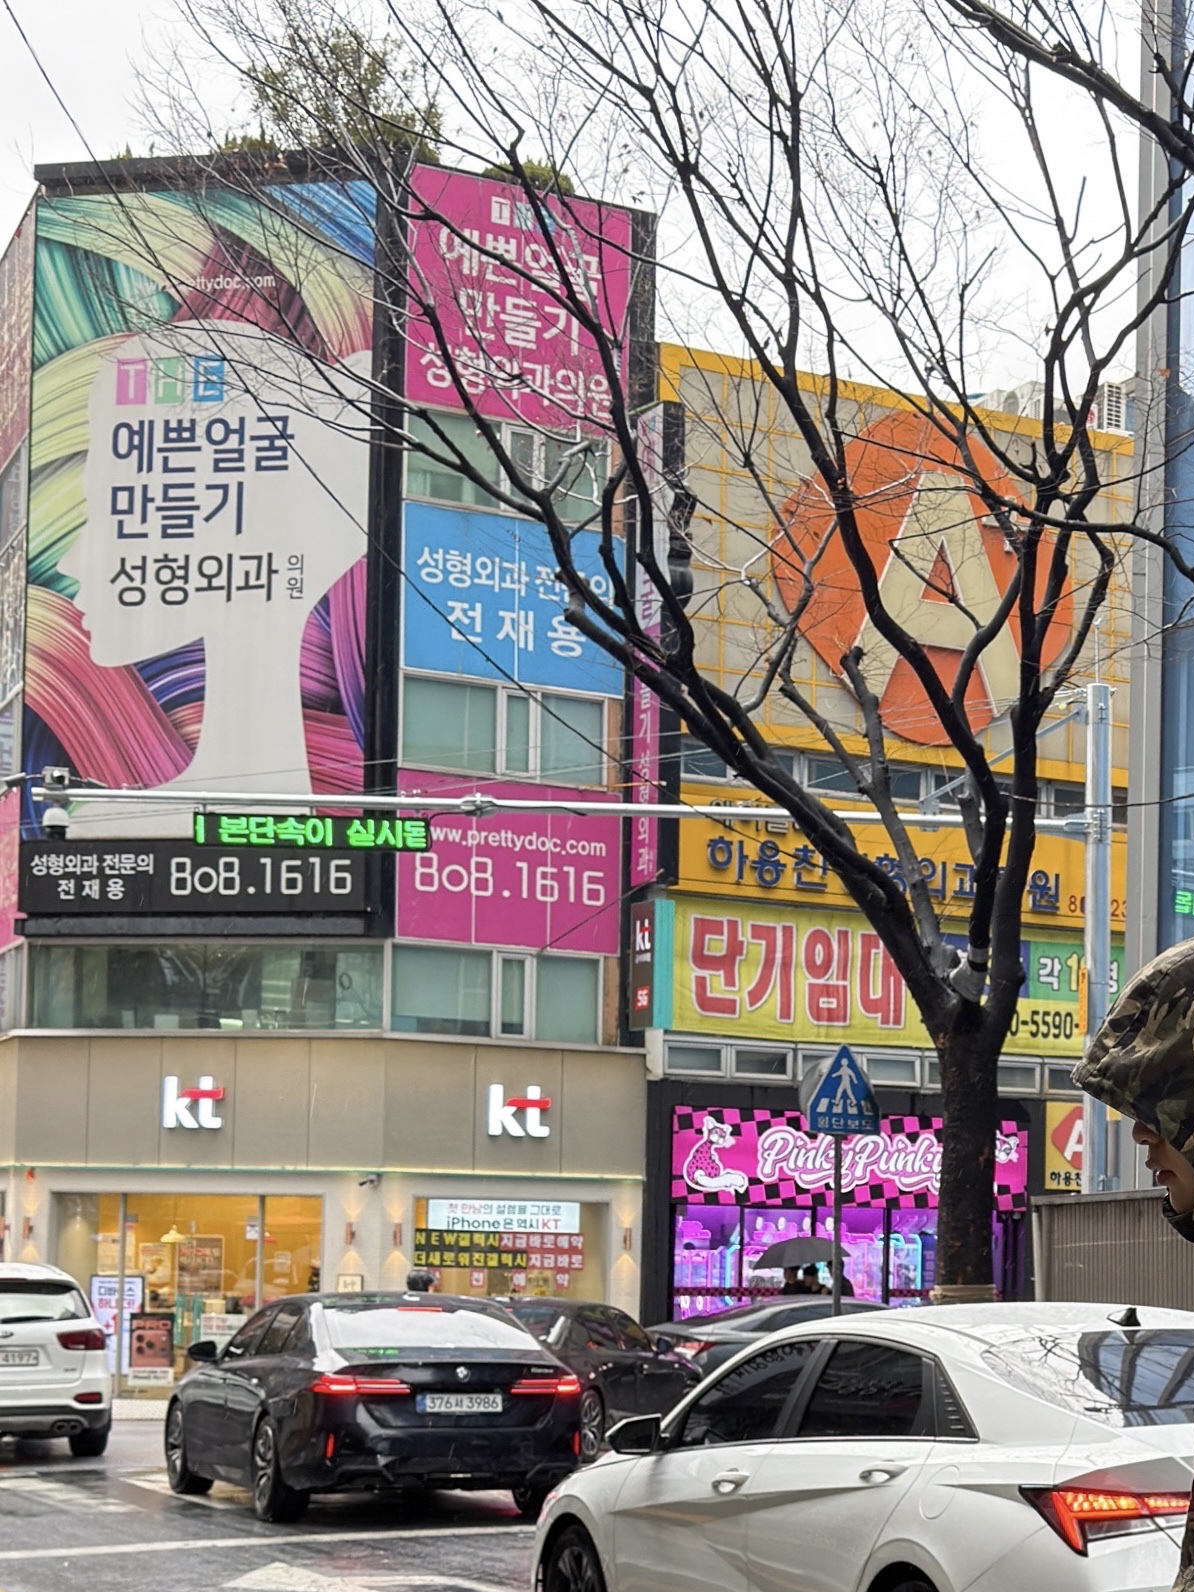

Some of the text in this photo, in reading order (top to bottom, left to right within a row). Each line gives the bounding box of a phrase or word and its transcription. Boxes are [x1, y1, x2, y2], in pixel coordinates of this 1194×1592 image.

[459, 287, 580, 357] 만들기
[116, 356, 225, 405] THE
[112, 415, 295, 474] 예쁜얼굴
[110, 481, 244, 540] 만들기
[110, 552, 279, 607] 성형외과
[286, 554, 304, 600] 의원
[416, 546, 530, 597] 성형외과
[533, 563, 615, 609] 전의
[30, 853, 155, 876] 성형외과 전문의
[635, 920, 651, 952] kt
[689, 914, 905, 1029] 단기임대
[162, 1075, 225, 1129] kt
[487, 1083, 552, 1138] kt
